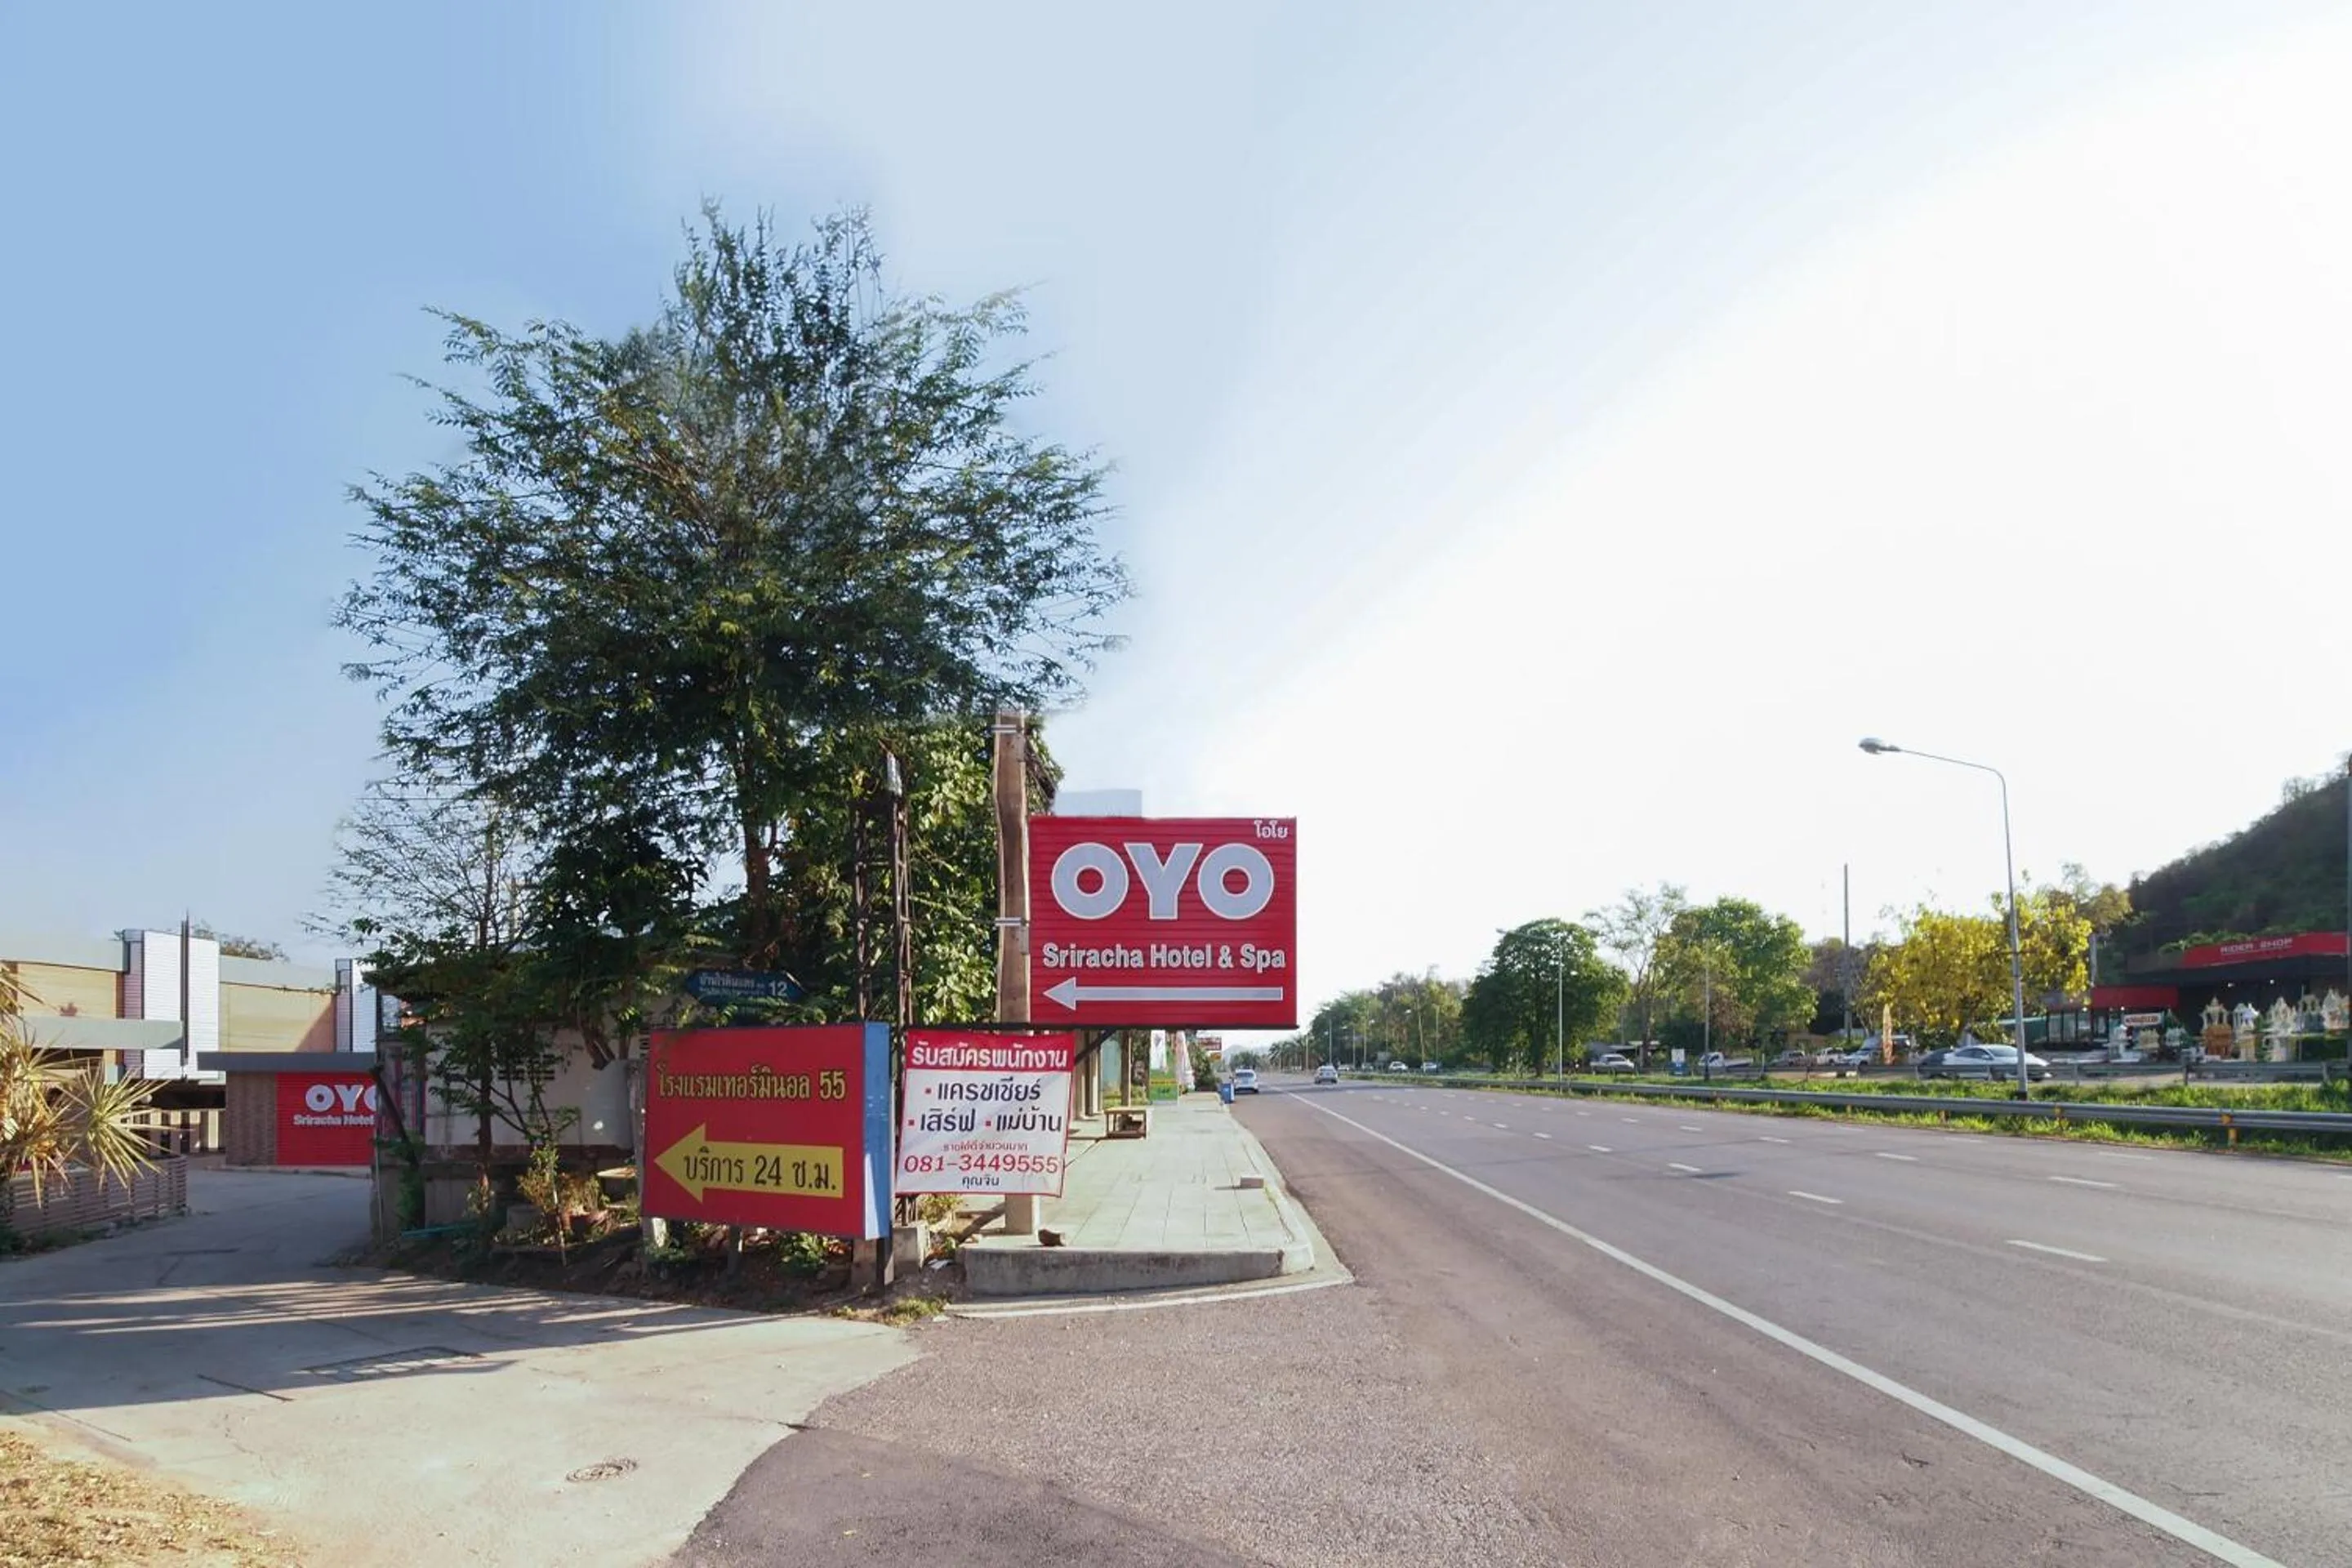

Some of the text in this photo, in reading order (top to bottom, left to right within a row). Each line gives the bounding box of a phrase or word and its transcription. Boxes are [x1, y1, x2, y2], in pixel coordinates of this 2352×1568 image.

[1051, 842, 1275, 920] OYO
[1042, 942, 1286, 973] Sriracha Hotel & Spa
[768, 980, 788, 996] 12
[911, 1041, 1067, 1068] รับสมัครพนักงาน
[656, 1062, 846, 1100] โรงแรมเทอร์มินอล 55
[293, 1114, 342, 1126] Sriracha
[996, 1106, 1062, 1133] แม่บ้าน
[683, 1147, 745, 1184] บริการ
[755, 1154, 782, 1187] 24
[903, 1152, 1059, 1174] 081-3449555
